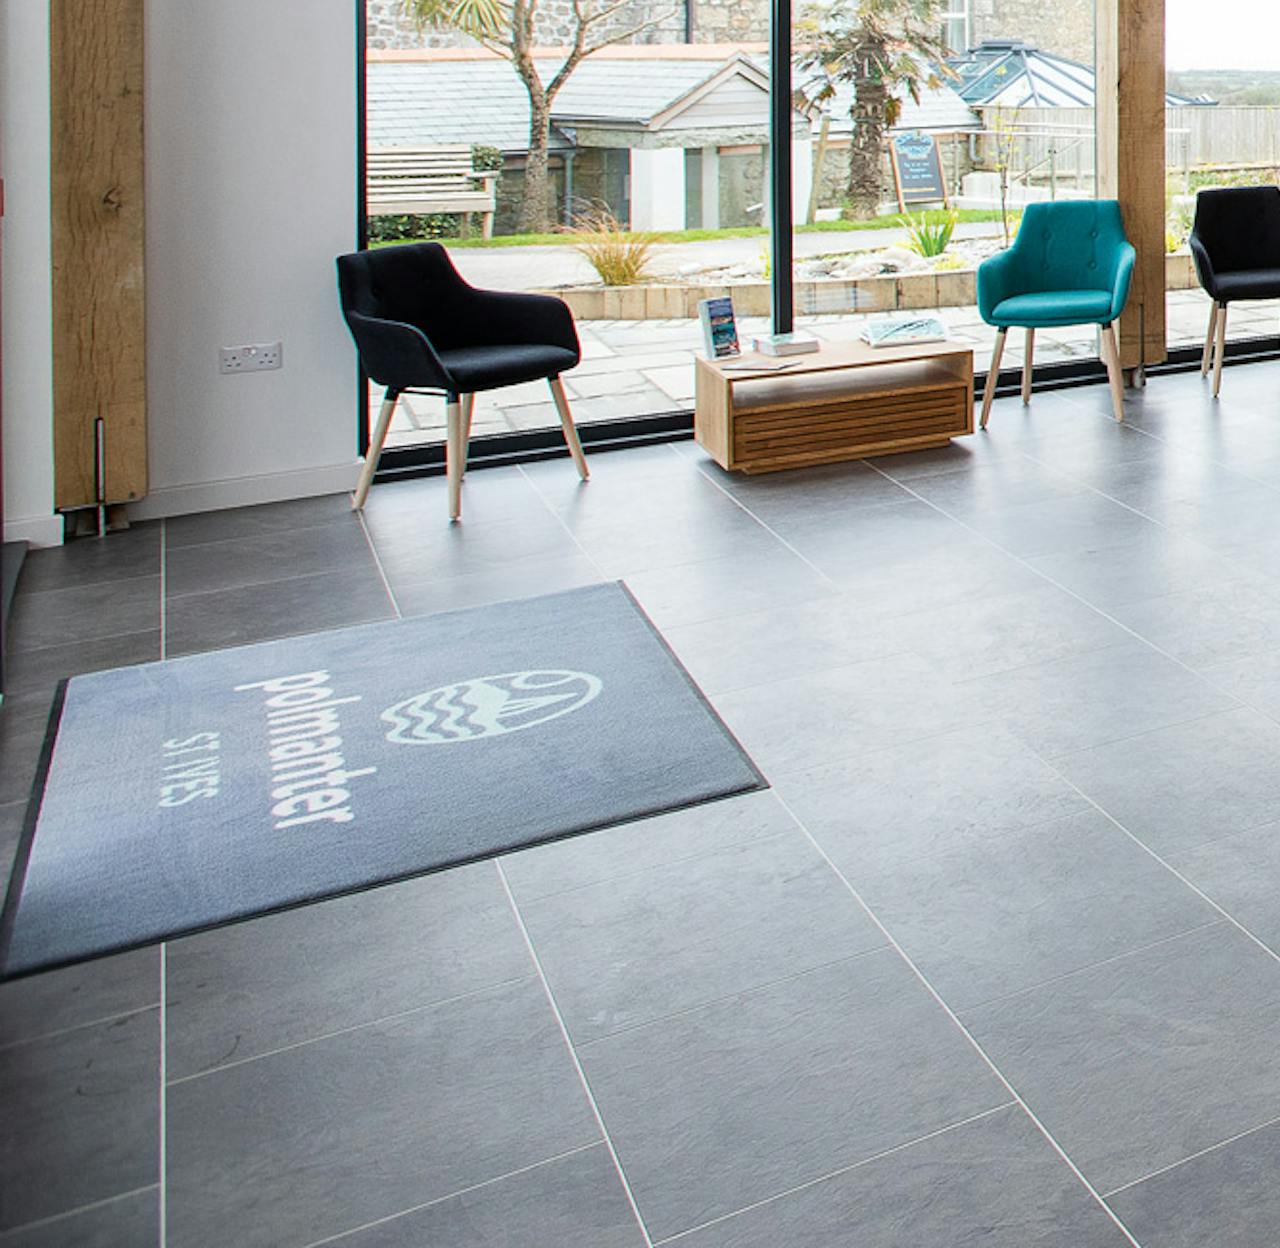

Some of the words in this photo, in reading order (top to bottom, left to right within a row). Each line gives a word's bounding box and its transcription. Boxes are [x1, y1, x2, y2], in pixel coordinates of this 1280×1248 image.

[162, 731, 220, 757] ST
[233, 669, 377, 829] polmanter
[158, 755, 220, 807] IVES
